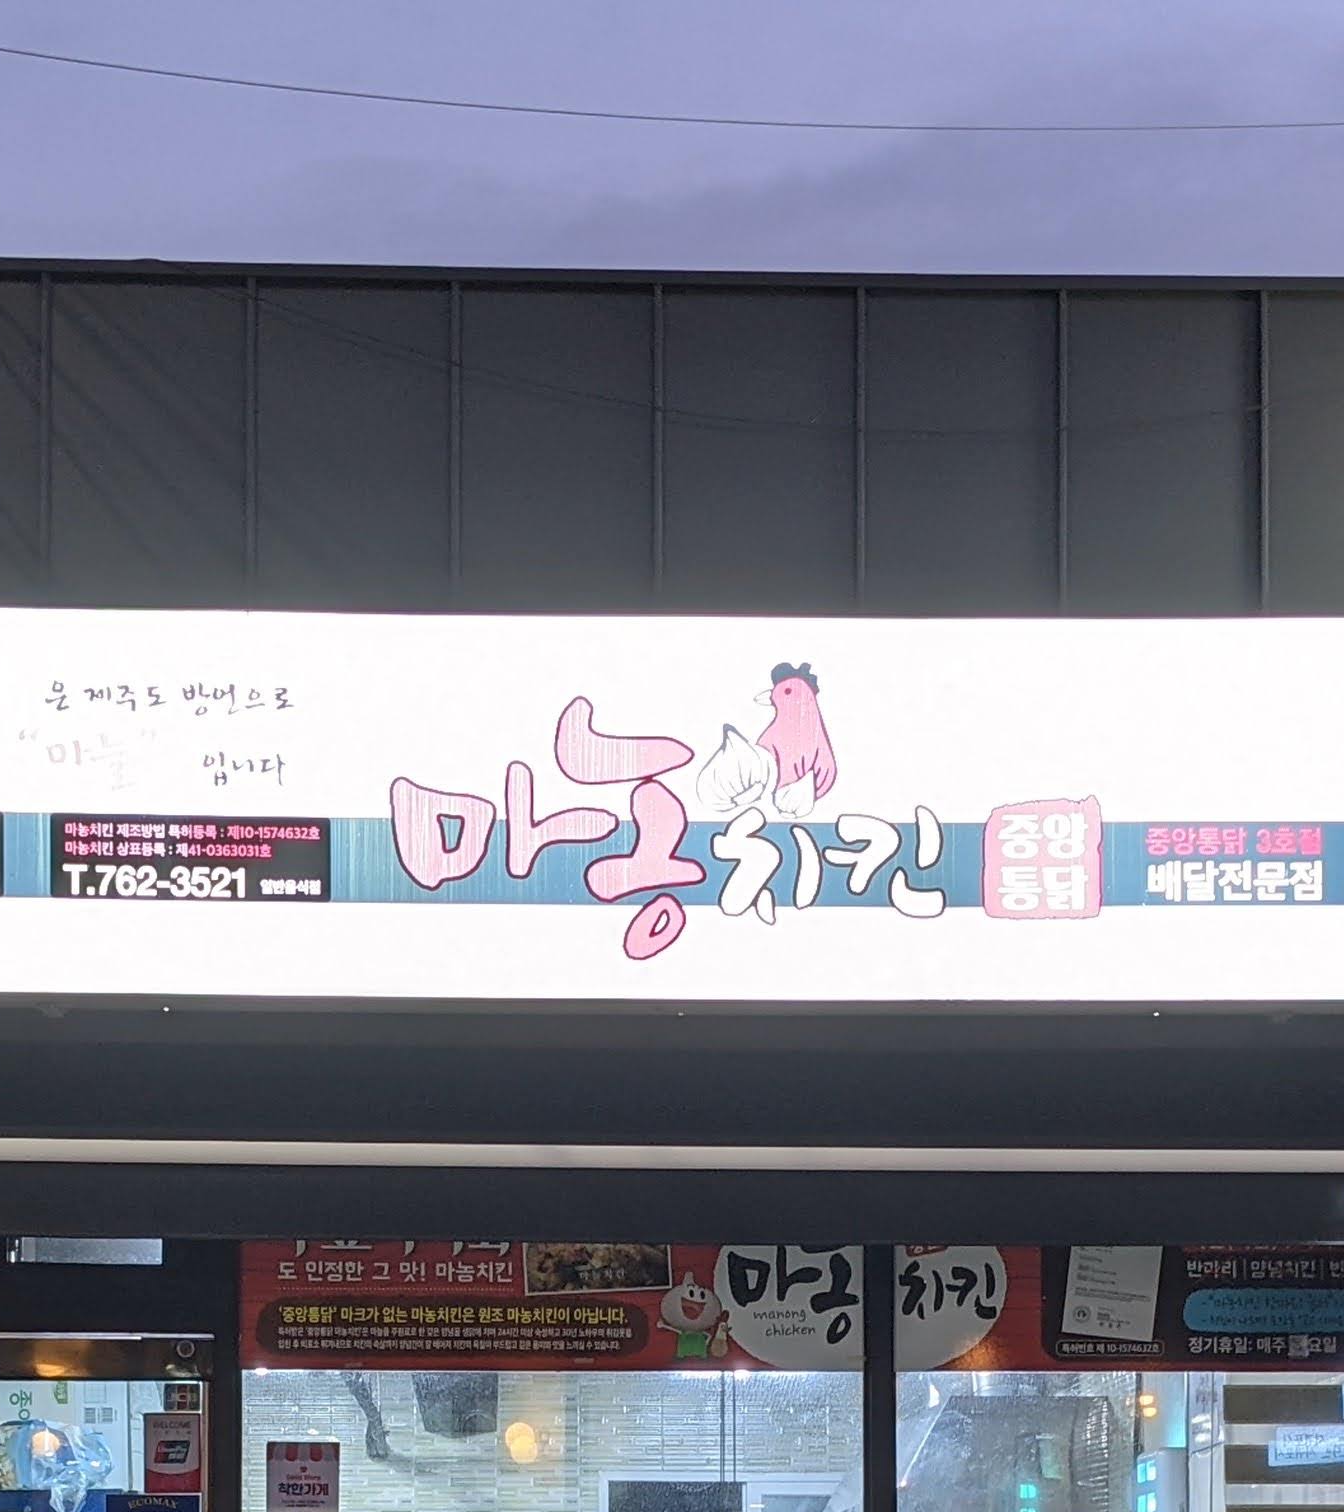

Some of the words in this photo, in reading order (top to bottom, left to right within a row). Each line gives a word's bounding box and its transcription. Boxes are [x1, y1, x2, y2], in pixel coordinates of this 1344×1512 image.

[44, 678, 71, 713] 은
[201, 749, 286, 788] 입니다
[63, 821, 115, 839] 마농치킨
[167, 823, 217, 841] 특허등록
[996, 812, 1089, 860] 중앙
[1145, 825, 1247, 856] 중앙통닭
[1255, 826, 1324, 856] 3호점
[63, 840, 115, 856] 마농치킨
[116, 841, 166, 857] 상표등록
[61, 863, 246, 899] T.762-3521
[996, 861, 1089, 913] 통닭
[1145, 860, 1324, 902] 배달전문점
[305, 1261, 364, 1284] 인정한
[372, 1263, 391, 1282] 그
[398, 1261, 427, 1284] 맛!
[898, 1259, 998, 1320] 치킨
[340, 1306, 380, 1324] 마크가
[382, 1306, 408, 1323] 없는
[410, 1306, 475, 1324] 마농치킨은
[477, 1307, 504, 1324] 원조
[506, 1307, 572, 1325] 마농치킨이
[752, 1308, 807, 1322] manong
[764, 1322, 817, 1337] chicken
[1255, 1336, 1287, 1355] 매주
[277, 1482, 330, 1497] 착한가게
